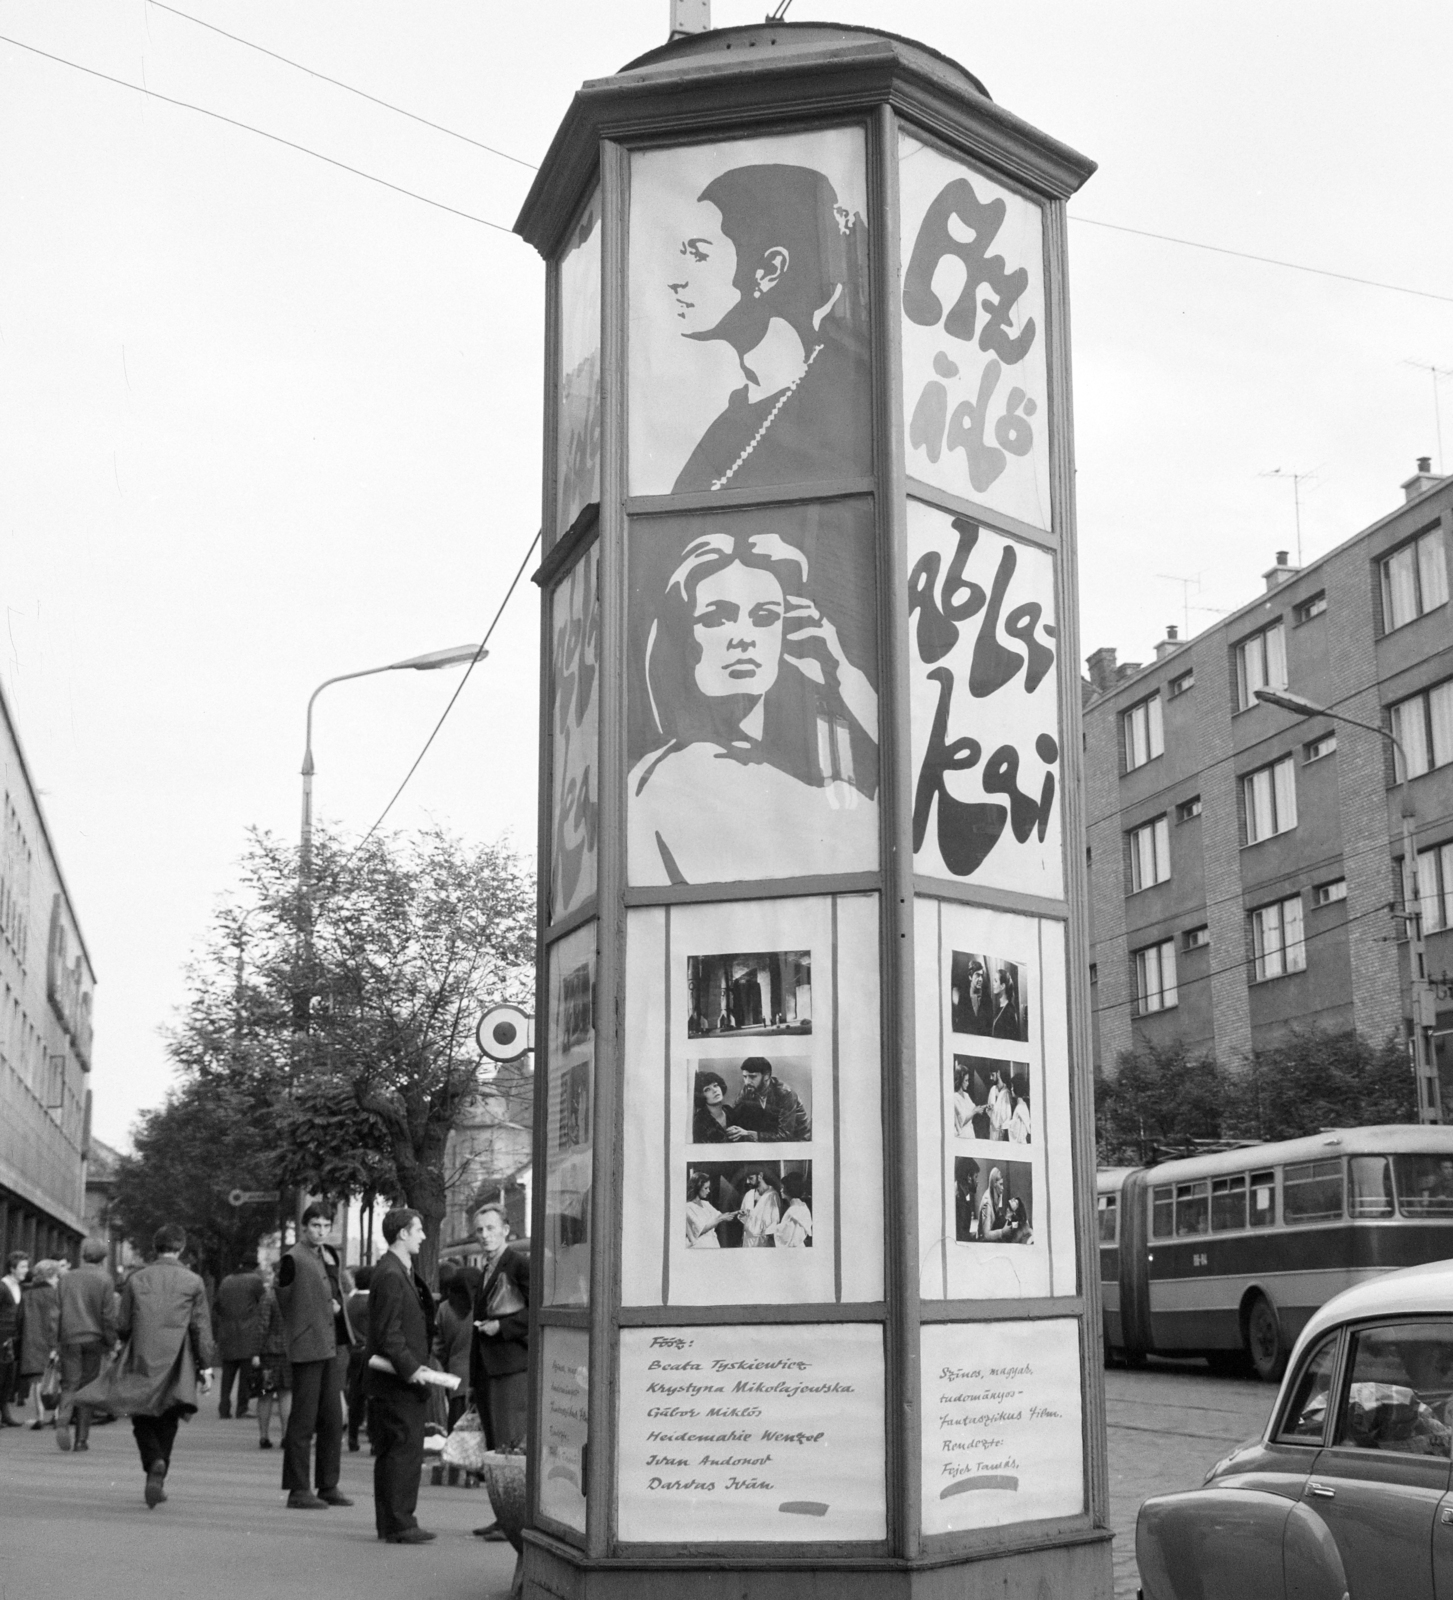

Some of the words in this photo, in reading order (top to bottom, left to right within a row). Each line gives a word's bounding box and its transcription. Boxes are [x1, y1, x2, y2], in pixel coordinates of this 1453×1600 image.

[909, 358, 1037, 493] idő
[912, 666, 1058, 876] kai
[648, 1360, 703, 1371] Beata
[711, 1358, 812, 1372] Tyskiewicz
[646, 1382, 724, 1397] Krystyna
[647, 1407, 700, 1418] Gábor
[706, 1407, 762, 1417] Miklós
[939, 1411, 1022, 1429] fantasztikus
[646, 1430, 752, 1442] Heidemarie
[761, 1430, 824, 1445] Wenzel
[942, 1438, 1003, 1451] Rendezte:
[646, 1455, 690, 1466] Ivan
[699, 1454, 773, 1466] Andonov
[647, 1477, 715, 1491] Darvas
